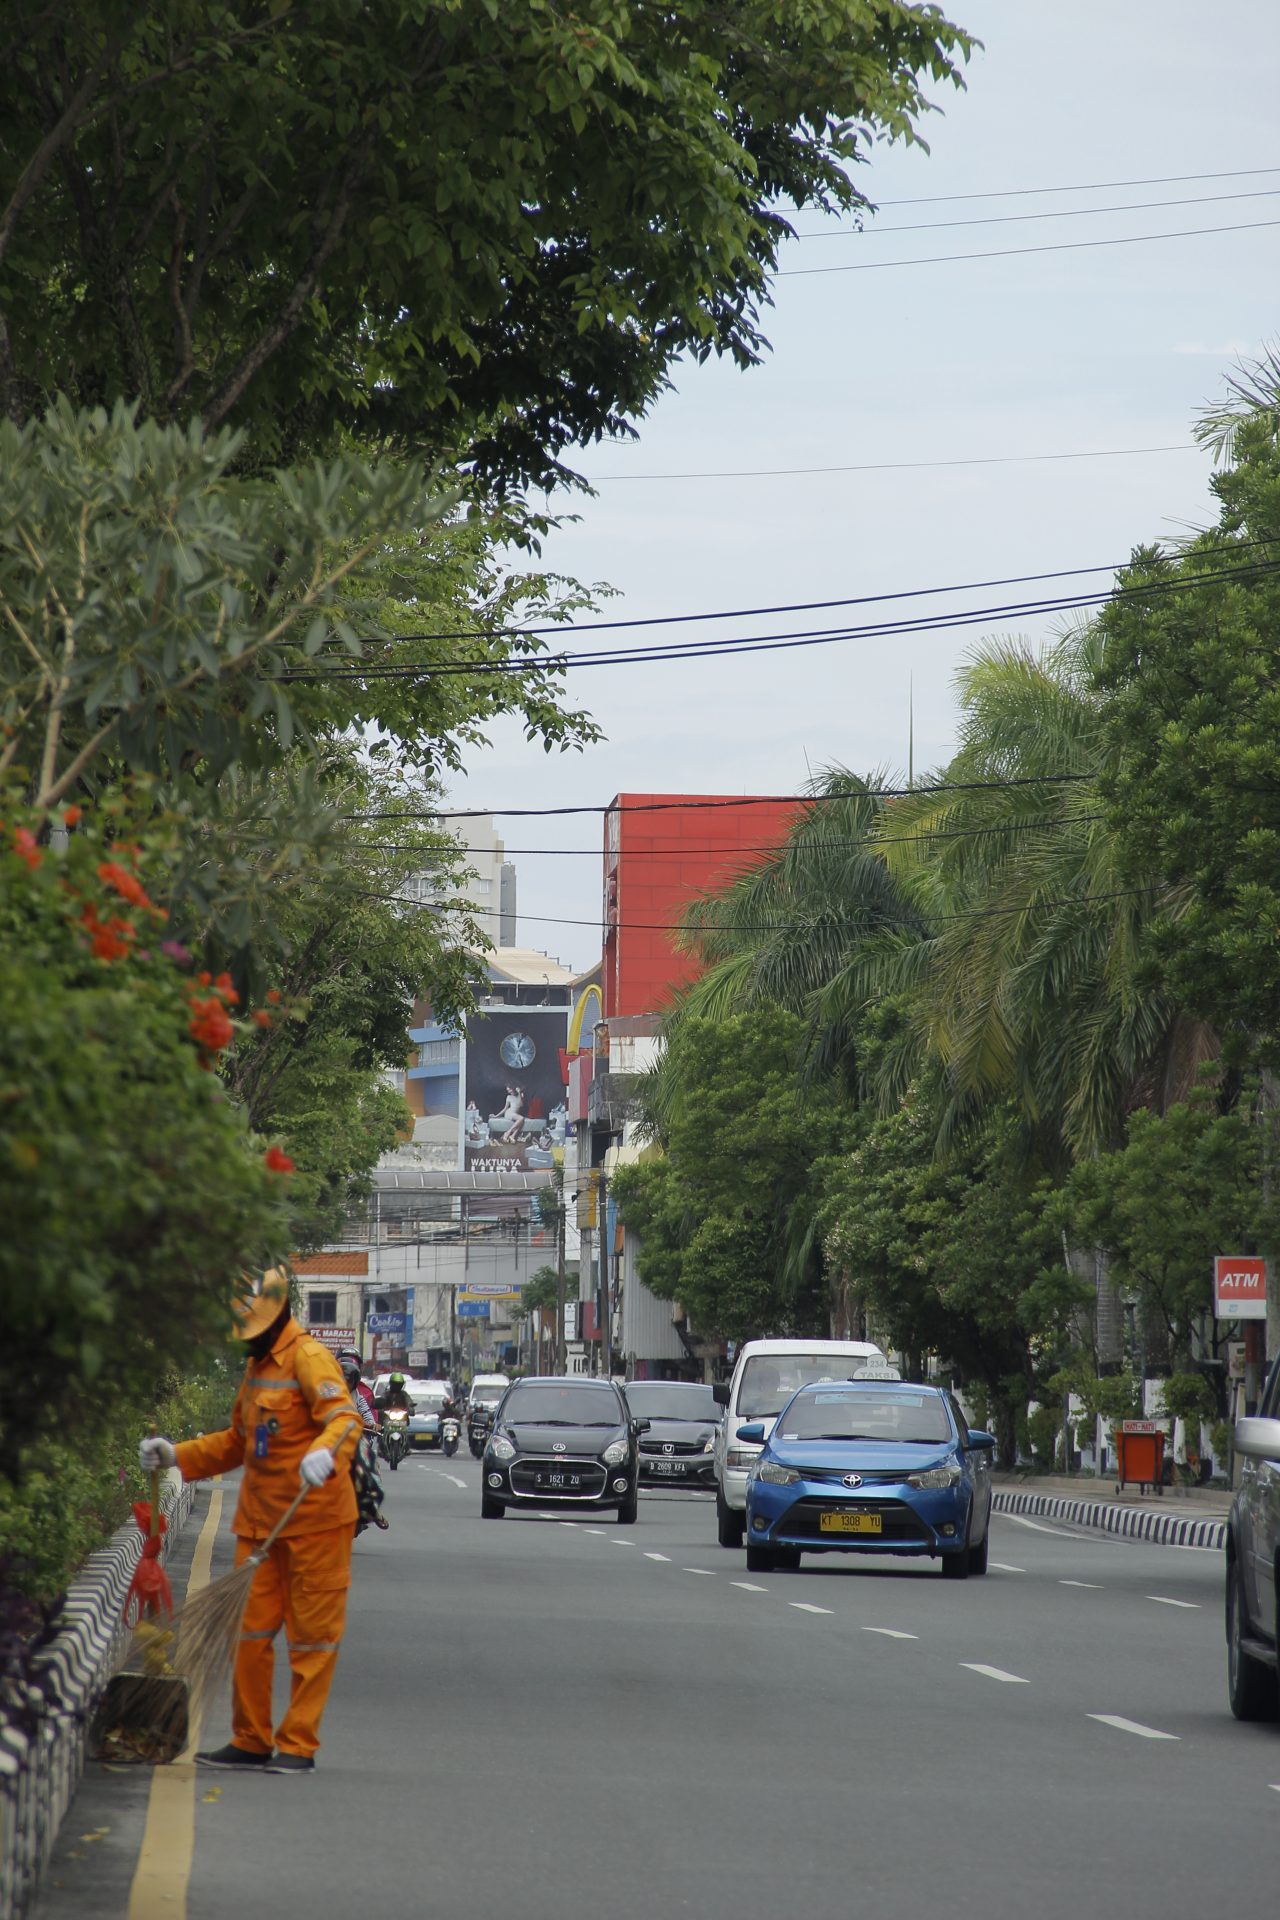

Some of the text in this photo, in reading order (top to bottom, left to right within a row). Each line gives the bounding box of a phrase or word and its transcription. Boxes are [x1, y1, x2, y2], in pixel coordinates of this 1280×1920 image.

[470, 1158, 522, 1166] WAKTUNYA
[1220, 1273, 1260, 1287] ATM
[870, 1360, 885, 1368] 234
[860, 1371, 895, 1379] TAKSI
[549, 1474, 564, 1484] 1621
[821, 1515, 881, 1527] KT 1308 YU
